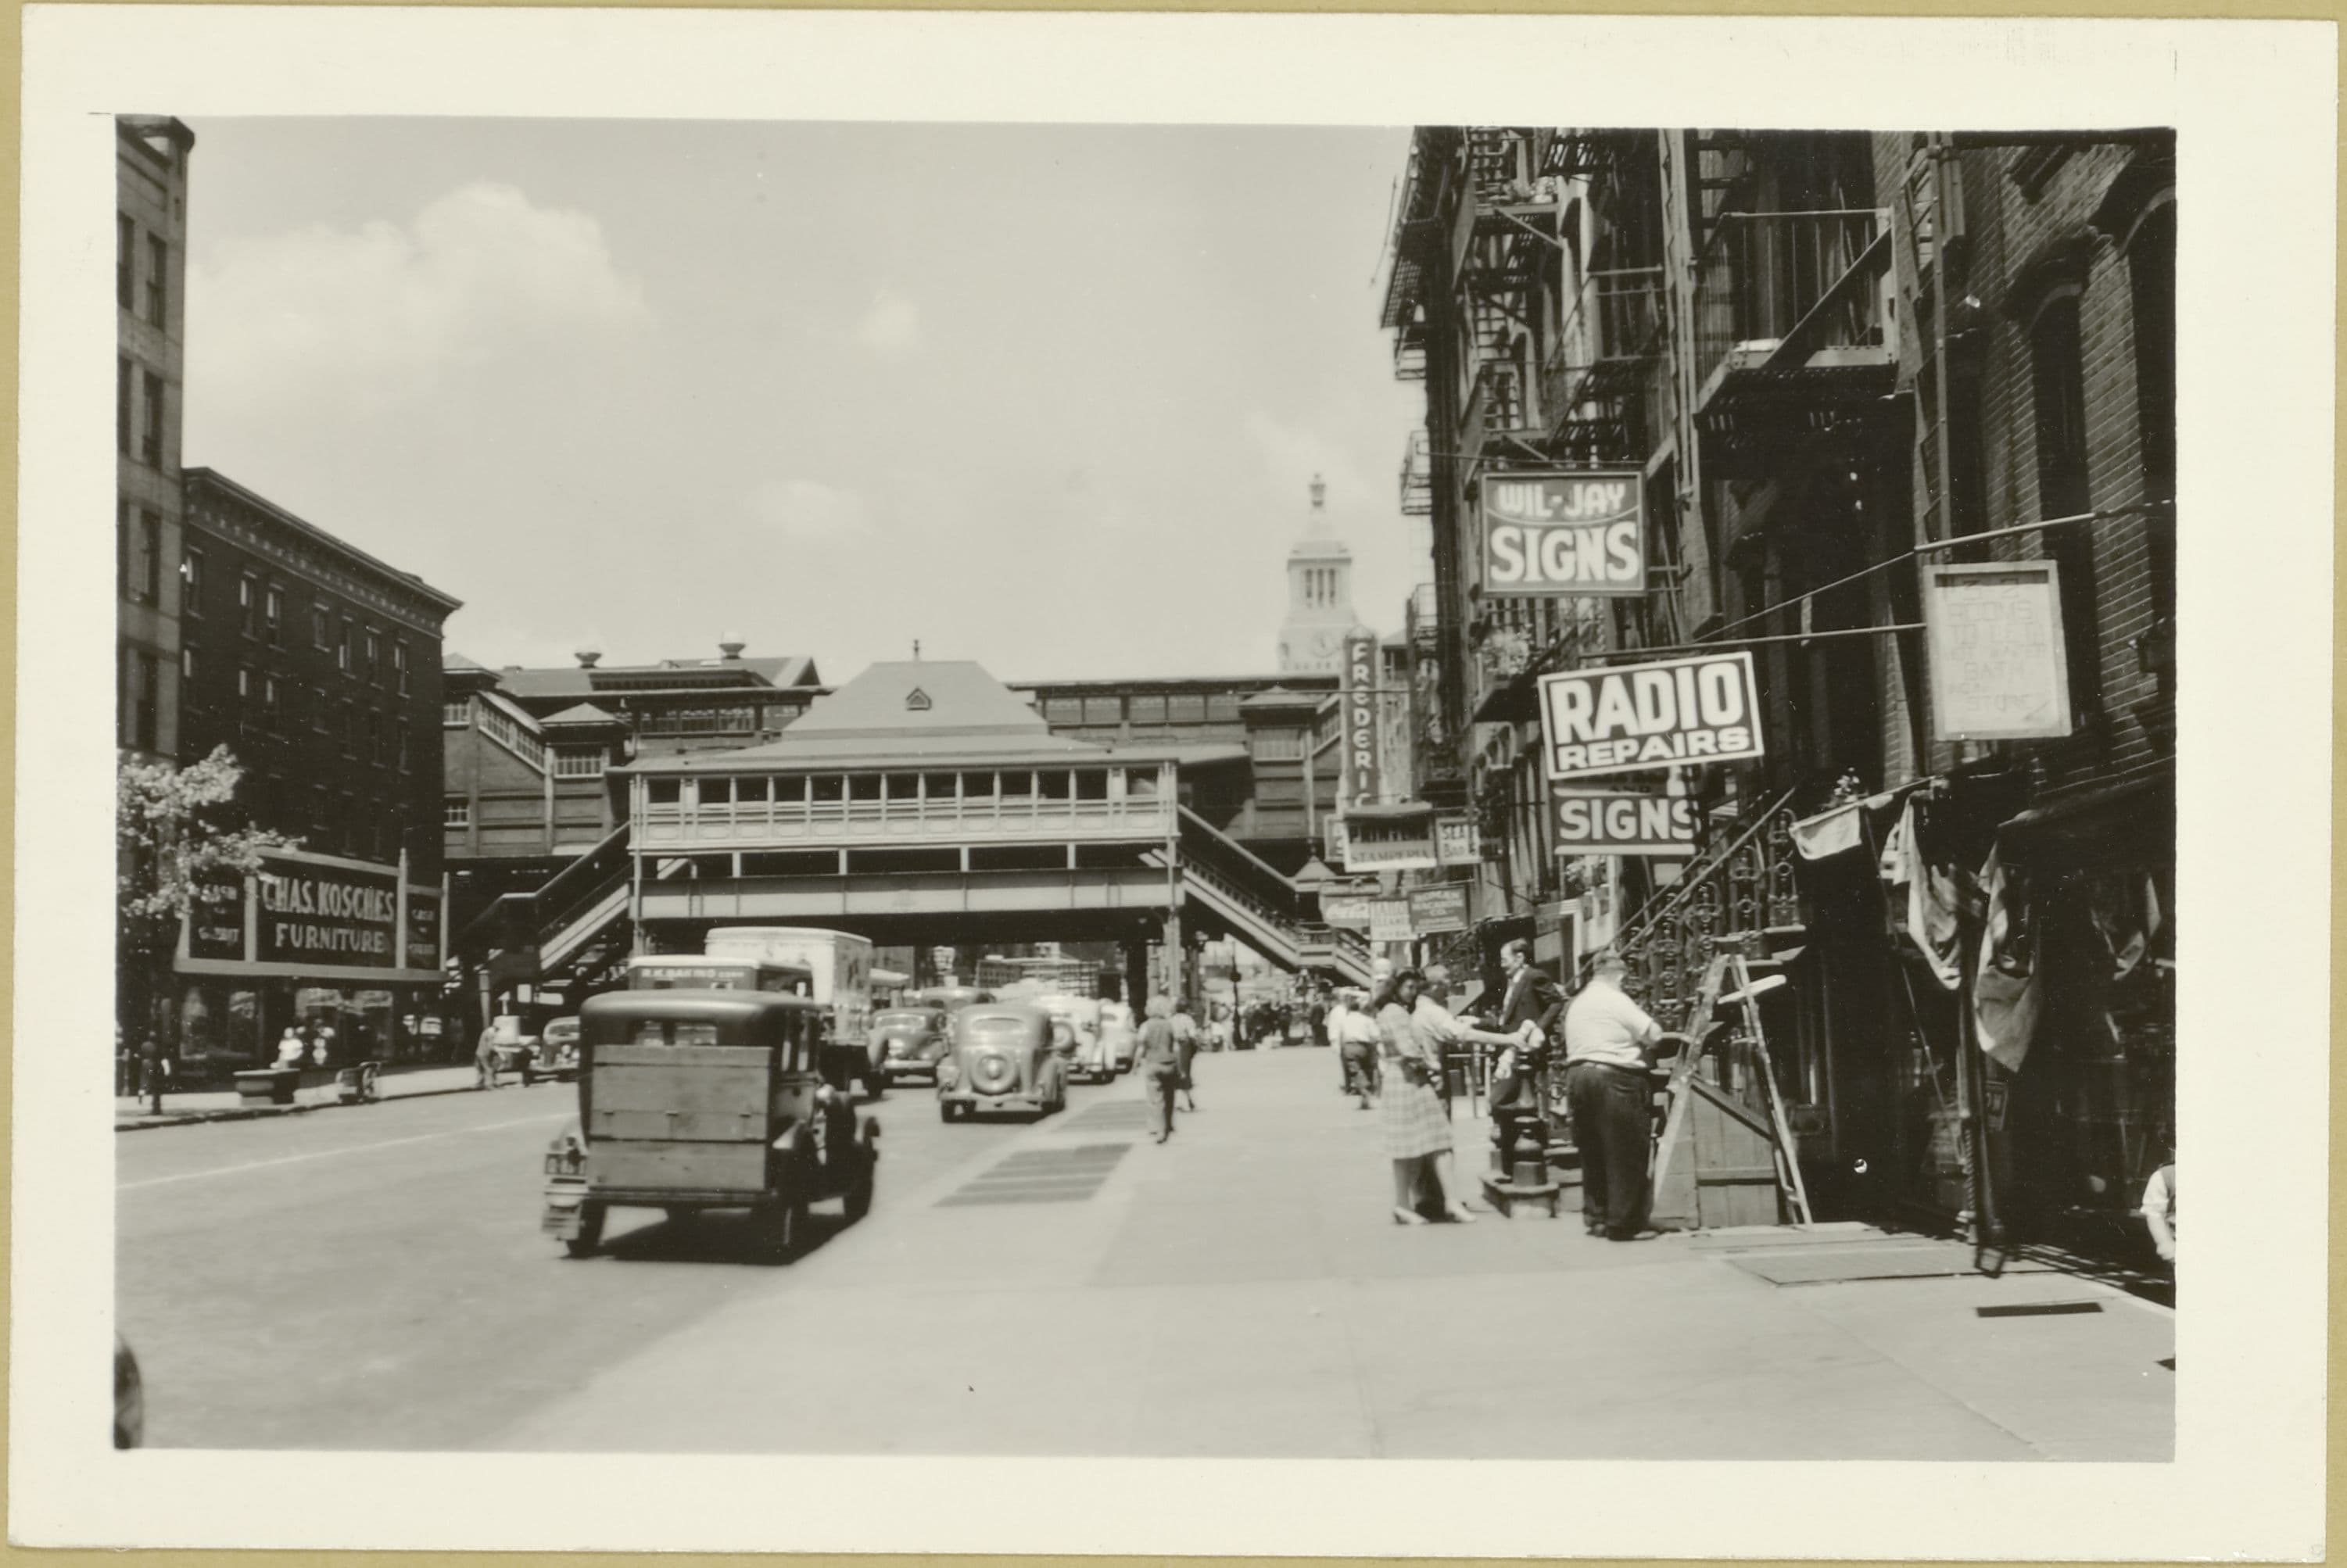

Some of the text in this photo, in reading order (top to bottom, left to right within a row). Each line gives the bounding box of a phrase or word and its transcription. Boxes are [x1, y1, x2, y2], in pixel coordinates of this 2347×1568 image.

[1496, 482, 1626, 519] WIL-JAY
[1489, 521, 1639, 583] SIGNS
[1550, 662, 1743, 744] RADIO
[1557, 726, 1750, 771] REPAIRS
[1559, 798, 1701, 840] SIGNS
[317, 881, 395, 922] KOSCHES
[275, 922, 386, 954] FURNITURE
